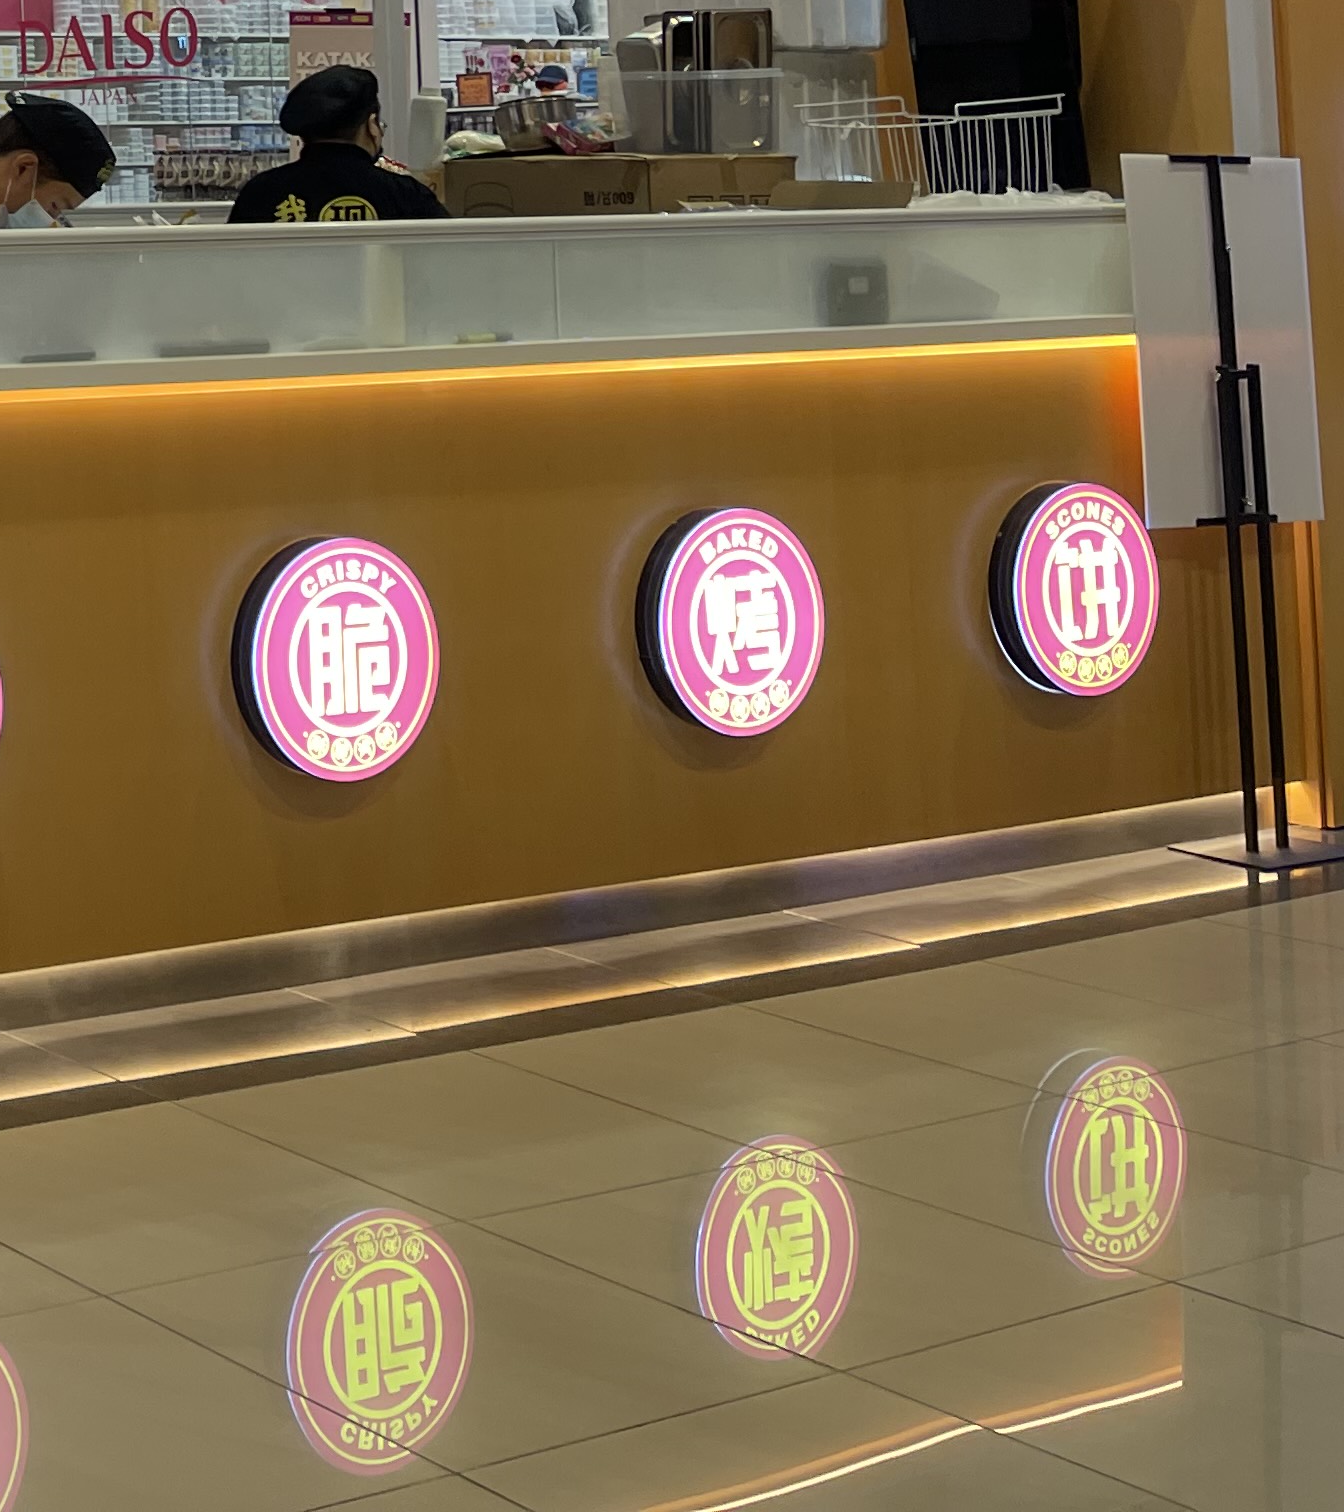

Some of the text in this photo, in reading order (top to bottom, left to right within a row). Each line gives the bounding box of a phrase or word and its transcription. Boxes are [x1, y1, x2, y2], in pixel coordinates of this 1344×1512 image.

[18, 7, 198, 76] DAISO
[295, 51, 375, 68] KATAK
[79, 88, 138, 106] JAPAN
[1045, 501, 1126, 540] SCONES
[698, 527, 779, 565] BAKED
[301, 559, 397, 599] CRISPY
[1055, 538, 1121, 641] 饼
[704, 570, 782, 676] 烤
[309, 603, 391, 717] 脆
